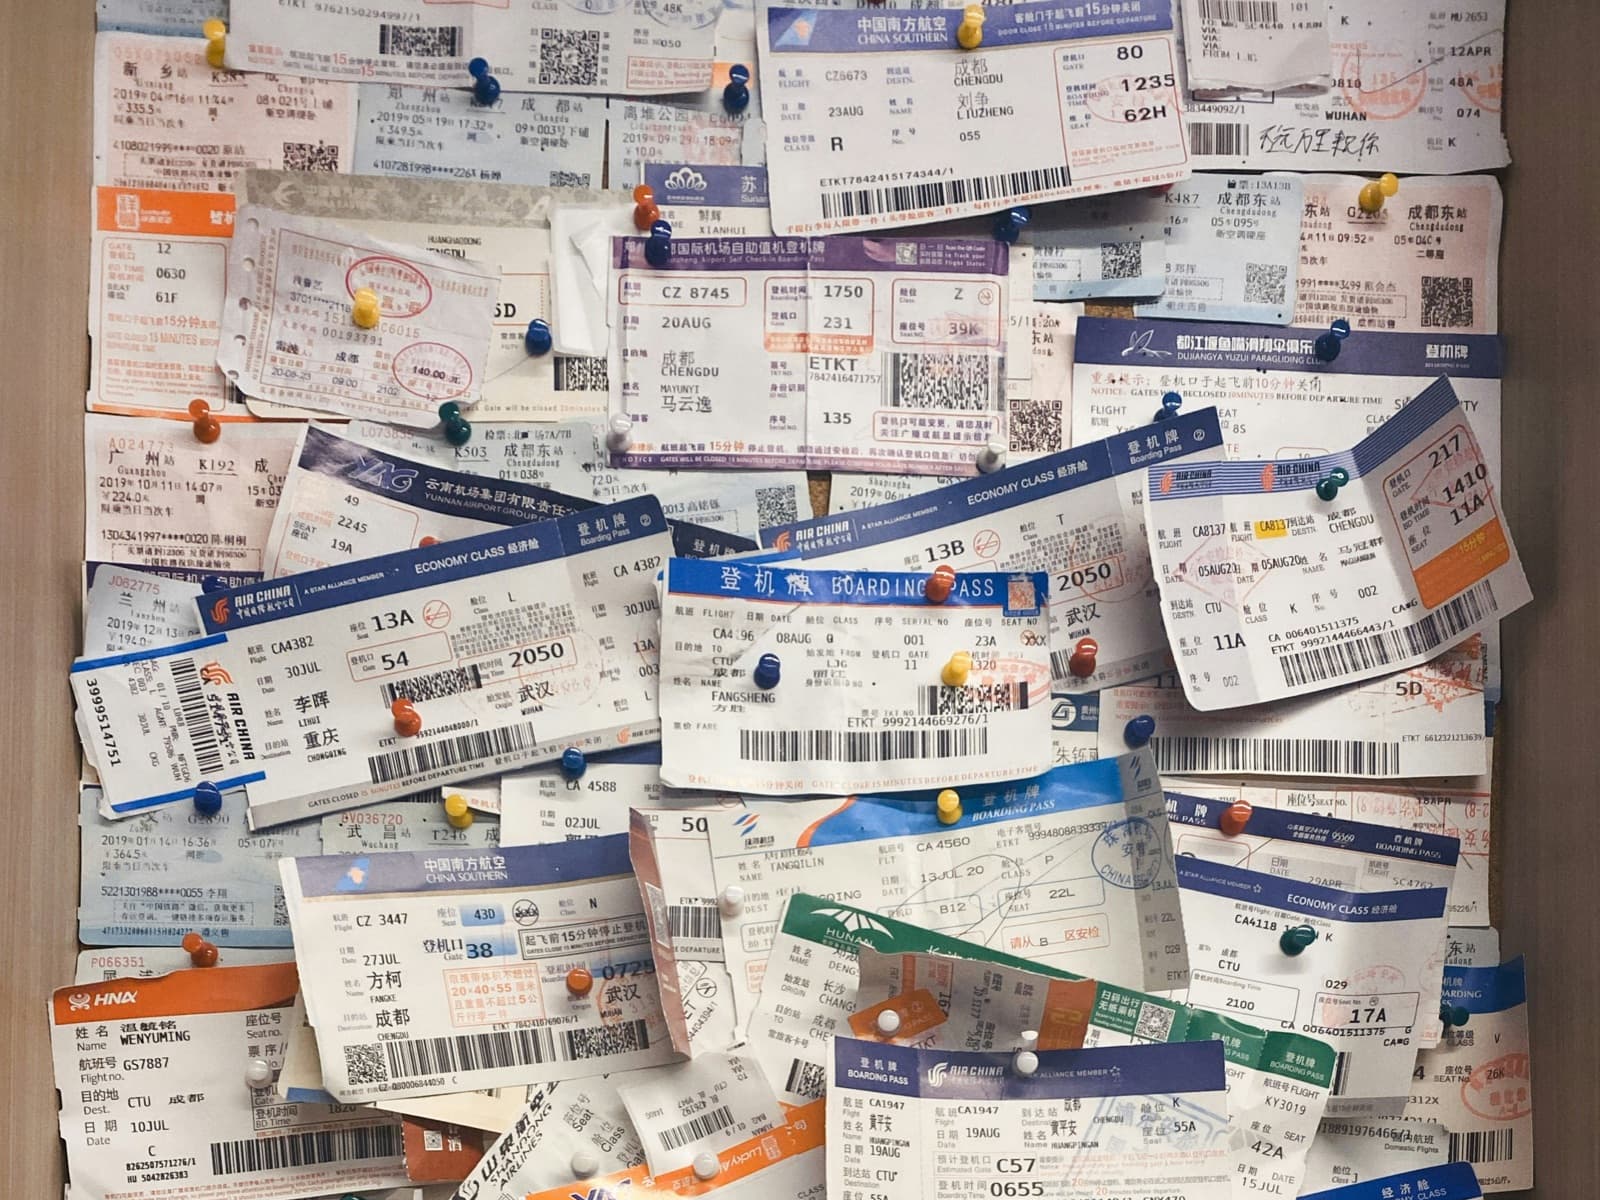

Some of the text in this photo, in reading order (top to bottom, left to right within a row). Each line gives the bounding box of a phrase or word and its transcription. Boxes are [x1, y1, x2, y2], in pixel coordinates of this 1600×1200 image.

[858, 17, 946, 32] 中国南方航空
[858, 33, 948, 44] CHINA SOUTHERN
[1116, 45, 1144, 60] 80
[1450, 46, 1492, 57] 12APR
[954, 74, 1003, 86] CHENGDU
[1122, 74, 1175, 92] 1235
[829, 107, 863, 117] 23AUG
[1124, 106, 1166, 122] 62H
[1325, 111, 1367, 122] WUHAN
[1457, 108, 1481, 118] 074
[960, 131, 980, 142] 055
[1448, 137, 1456, 146] K
[831, 137, 843, 151] R
[157, 243, 172, 254] 12
[156, 268, 186, 279] 0630
[156, 291, 178, 303] 61F
[662, 287, 729, 299] CZ 8745
[824, 285, 863, 299] 1750
[954, 288, 963, 300] Z
[662, 317, 711, 329] 20AUG
[823, 317, 852, 329] 231
[810, 357, 856, 372] ETKT
[661, 367, 719, 377] CHENGDU
[661, 385, 700, 394] MAYUNYI
[661, 395, 712, 412] 马云逸
[823, 412, 852, 424] 135
[1428, 434, 1462, 468] 217
[1442, 463, 1487, 503] 1410
[1451, 495, 1485, 525] 11A
[337, 516, 369, 534] 2245
[1193, 524, 1225, 538] CA8137
[1329, 514, 1374, 534] CHENGDU
[925, 540, 965, 564] 13B
[414, 546, 505, 575] ECONOMY CLASS
[1057, 564, 1111, 592] 2050
[832, 574, 994, 597] BOARDING PASS
[1358, 585, 1377, 599] 002
[1205, 602, 1222, 614] CTU
[371, 610, 414, 632] 13A
[776, 632, 812, 644] 08AUG
[904, 634, 924, 646] 001
[975, 636, 997, 647] 23A
[1213, 633, 1246, 651] 11A
[271, 636, 314, 655] CA4382
[382, 651, 409, 670] 54
[508, 640, 564, 668] 2050
[904, 659, 918, 670] 11
[518, 680, 551, 703] 武汉
[1396, 681, 1423, 696] 5D
[712, 691, 776, 704] FANGSHENG
[87, 678, 121, 766] 3999514751
[303, 728, 340, 750] 重庆
[939, 902, 966, 915] B12
[1287, 893, 1369, 916] ECONOMY CLASS
[357, 913, 408, 927] CZ 3447
[474, 909, 495, 919] 43D
[467, 943, 493, 959] 38
[363, 954, 400, 966] 27JUL
[1218, 959, 1240, 972] CTU
[1325, 979, 1348, 990] 029
[1226, 996, 1256, 1012] 2100
[376, 1008, 410, 1028] 成都
[1348, 1007, 1388, 1026] 17A
[120, 1030, 191, 1046] WENYUMING
[123, 1057, 169, 1071] GS7887
[127, 1095, 152, 1109] CTU
[869, 1098, 905, 1111] CA1947
[1264, 1094, 1307, 1117] KY3019
[958, 1105, 999, 1116] CA1947
[130, 1120, 169, 1133] 10JUL
[965, 1127, 1000, 1140] 19AUG
[1174, 1121, 1197, 1133] 55A
[1251, 1139, 1285, 1160] 42A
[996, 1158, 1036, 1174] C57
[990, 1181, 1044, 1198] 0655
[1241, 1176, 1283, 1196] 15JUL
